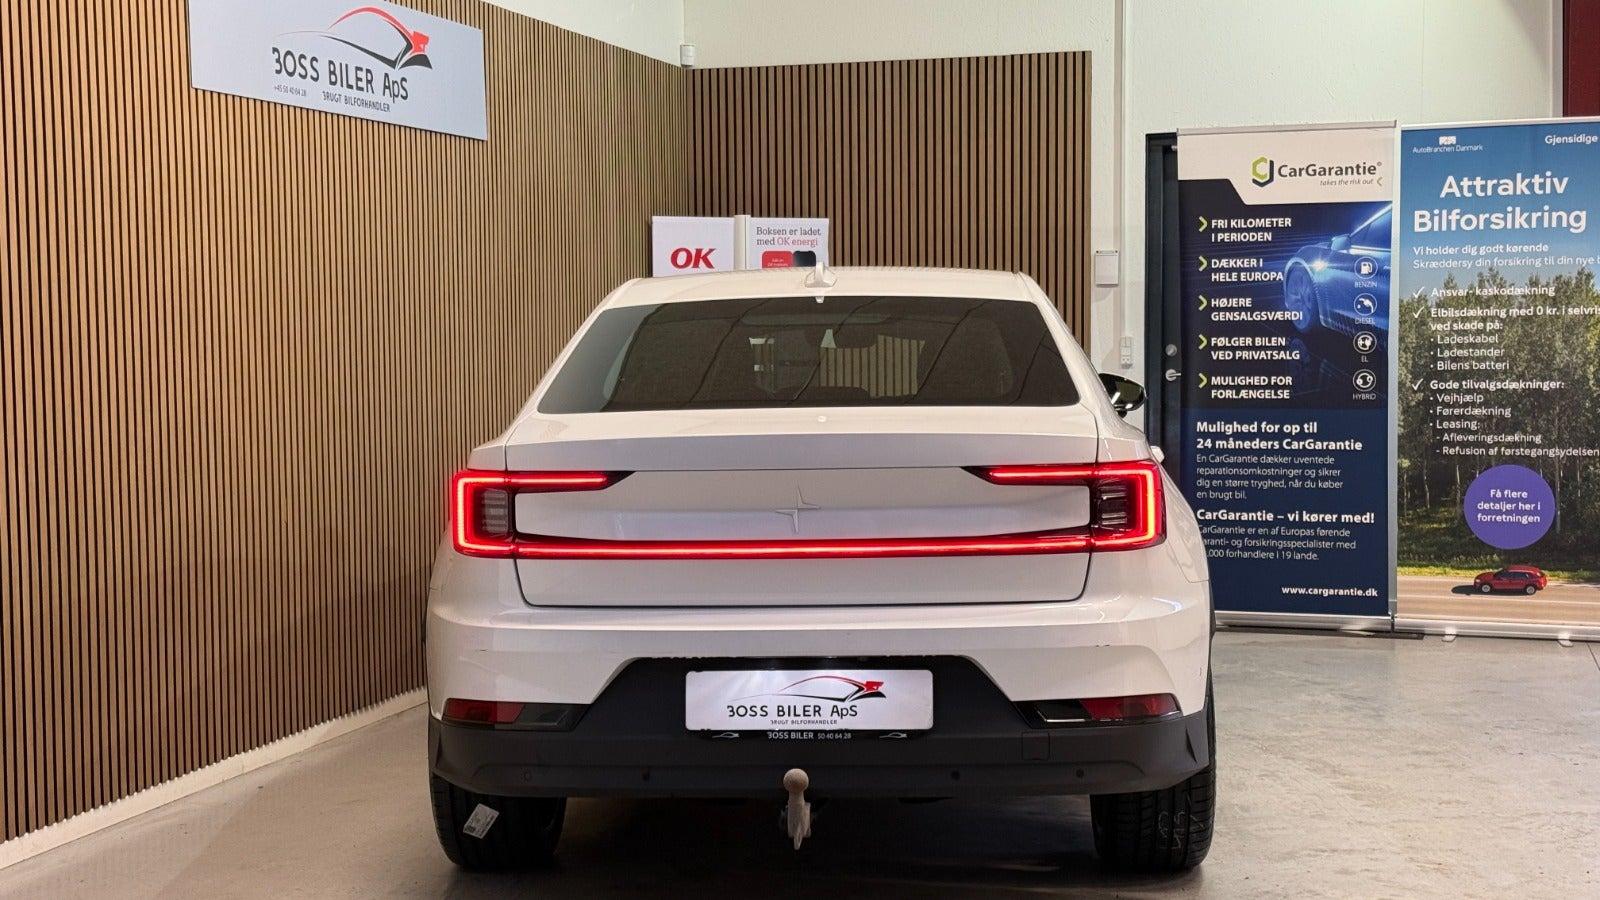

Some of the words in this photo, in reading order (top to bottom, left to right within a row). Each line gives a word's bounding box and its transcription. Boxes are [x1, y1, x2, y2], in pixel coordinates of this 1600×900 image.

[328, 60, 374, 94] BILER
[382, 72, 409, 103] ApS
[344, 95, 391, 113] BILFORHANDLER
[1544, 134, 1598, 146] Gjensidige
[1412, 146, 1454, 154] AutoBranchen
[1456, 144, 1483, 152] Danmark
[1439, 171, 1569, 198] Attraktiv
[1211, 219, 1228, 229] FRI
[1230, 218, 1292, 228] KILOMETER
[1414, 205, 1587, 233] Bilforsikring
[756, 227, 787, 236] Boksen
[800, 227, 821, 236] ladet
[1211, 233, 1215, 242] I
[1217, 232, 1272, 242] PERIODEN
[757, 238, 776, 246] med
[777, 237, 790, 246] OK
[792, 238, 818, 248] energi
[1413, 246, 1424, 255] Vi
[1425, 245, 1459, 255] holder
[1461, 244, 1477, 255] dig
[1479, 244, 1503, 255] godt
[1506, 243, 1548, 253] kørende
[670, 247, 716, 269] OK
[1211, 259, 1257, 268] DÆKKER
[1260, 259, 1263, 267] I
[1413, 258, 1472, 269] Skræddersy
[1475, 257, 1490, 267] din
[1494, 256, 1541, 267] forsikring
[1544, 256, 1555, 265] til
[1557, 256, 1573, 265] din
[1575, 257, 1594, 267] nye
[1211, 273, 1238, 282] HELE
[1240, 272, 1284, 281] EUROPA
[1430, 287, 1473, 297] Ansvar-
[1475, 285, 1555, 296] kaskodækning
[1211, 298, 1252, 308] HØJERE
[1211, 311, 1303, 321] GENSALGSVÆRDI
[1431, 307, 1507, 318] Elbilsdækning
[1509, 306, 1534, 316] med
[1536, 306, 1543, 316] 0
[1546, 306, 1560, 315] kr.
[1430, 322, 1450, 330] ved
[1453, 321, 1484, 330] skade
[1486, 320, 1503, 332] på:
[1211, 337, 1252, 347] FØLGER
[1255, 337, 1286, 346] BILEN
[1437, 334, 1499, 344] Ladeskabel
[1211, 351, 1233, 360] VED
[1236, 350, 1300, 360] PRIVATSALG
[1437, 347, 1505, 357] Ladestander
[1437, 361, 1469, 370] Bilens
[1472, 360, 1509, 370] batteri
[1211, 376, 1268, 386] MULIGHED
[1271, 376, 1293, 386] FOR
[1430, 380, 1459, 390] Gode
[1462, 380, 1564, 391] tilvalgsdækninger:
[1211, 390, 1290, 399] FORLÆNGELSE
[1436, 393, 1484, 404] Vejhjælp
[1437, 406, 1511, 417] Førerdækning
[1196, 421, 1258, 434] Mulighed
[1260, 421, 1280, 433] for
[1283, 424, 1300, 435] op
[1303, 422, 1317, 433] til
[1443, 433, 1542, 443] Afleveringsdækning
[1196, 439, 1212, 449] 24
[1215, 438, 1280, 449] måneders
[1282, 439, 1363, 450] CarGarantie
[1442, 446, 1485, 455] Refusion
[1488, 446, 1498, 455] af
[1501, 447, 1600, 459] førstegangsydelsen
[1196, 454, 1207, 463] En
[1209, 454, 1258, 463] CarGarantie
[1260, 455, 1292, 464] dækker
[1294, 455, 1335, 464] uventede
[1196, 466, 1302, 477] reparationsomkostninger
[1305, 469, 1315, 477] og
[1318, 468, 1340, 477] sikrer
[1196, 479, 1209, 488] dig
[1224, 479, 1249, 487] større
[1251, 479, 1287, 490] tryghed,
[1289, 480, 1303, 488] når
[1305, 480, 1316, 488] du
[1318, 480, 1343, 489] køber
[1209, 490, 1233, 500] brugt
[1234, 490, 1247, 499] bil.
[1490, 489, 1501, 498] Få
[1504, 489, 1528, 498] flere
[1477, 501, 1516, 512] detaljer
[1519, 502, 1535, 510] her
[1197, 509, 1274, 521] CarGarantie
[1287, 511, 1299, 521] vi
[1302, 511, 1338, 523] kører
[1341, 512, 1375, 523] med!
[1477, 513, 1540, 524] forretningen
[1271, 527, 1279, 535] af
[1281, 527, 1315, 538] Europas
[1316, 528, 1350, 536] førende
[1231, 539, 1242, 548] og
[1244, 537, 1334, 549] forsikringsspecialister
[1335, 541, 1356, 549] med
[1226, 549, 1274, 559] forhandlere
[1281, 551, 1291, 560] 19
[1293, 551, 1319, 560] lande.
[1282, 586, 1378, 597] www.cargarantie.dk
[777, 705, 822, 717] BILER
[830, 705, 858, 720] ApS
